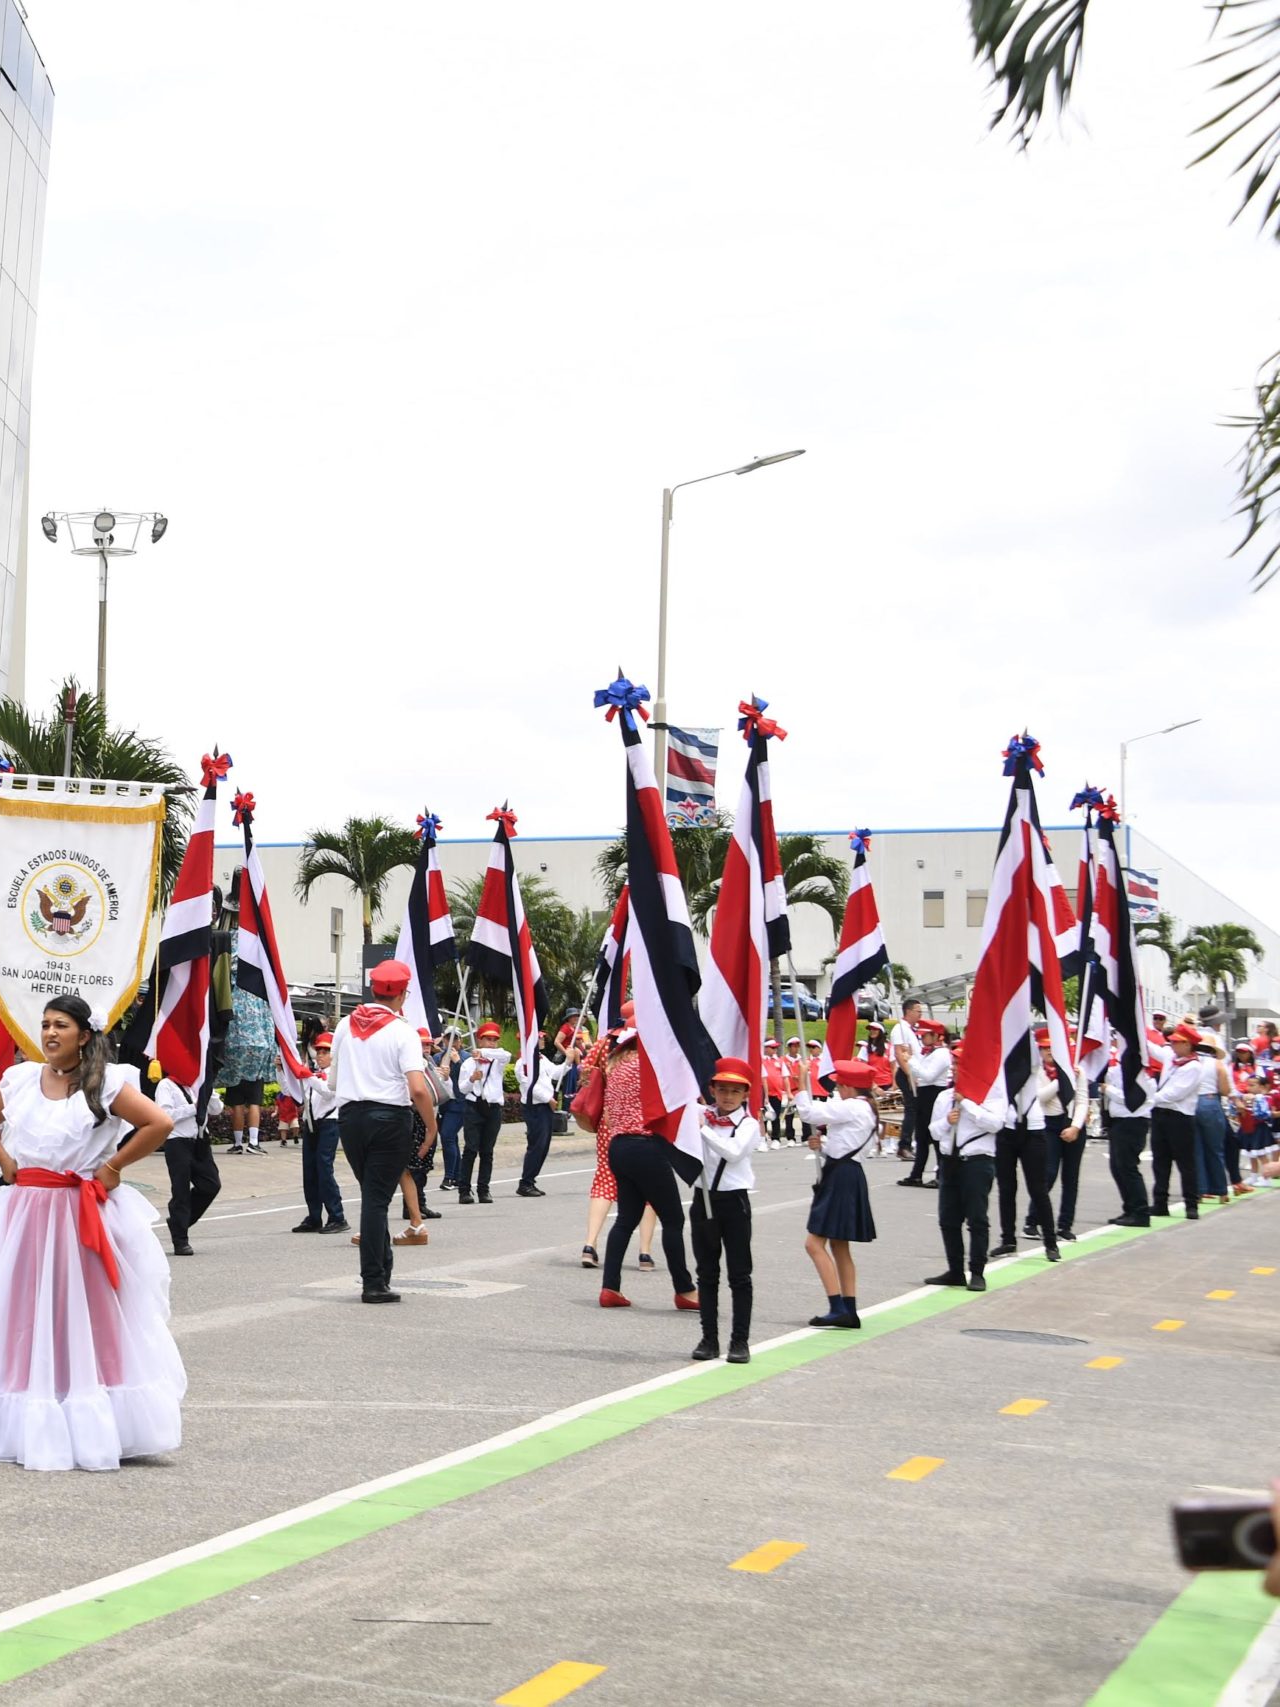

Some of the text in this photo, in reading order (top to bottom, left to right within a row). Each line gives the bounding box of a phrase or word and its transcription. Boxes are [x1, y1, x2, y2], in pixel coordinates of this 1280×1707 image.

[7, 849, 119, 921] ESCUELA ESTADOS UNIDOS DE AMERICA
[46, 960, 71, 972] 1943
[1, 966, 114, 987] SAN JOAQUIN DE FLORES
[31, 983, 80, 997] HEREDIA
